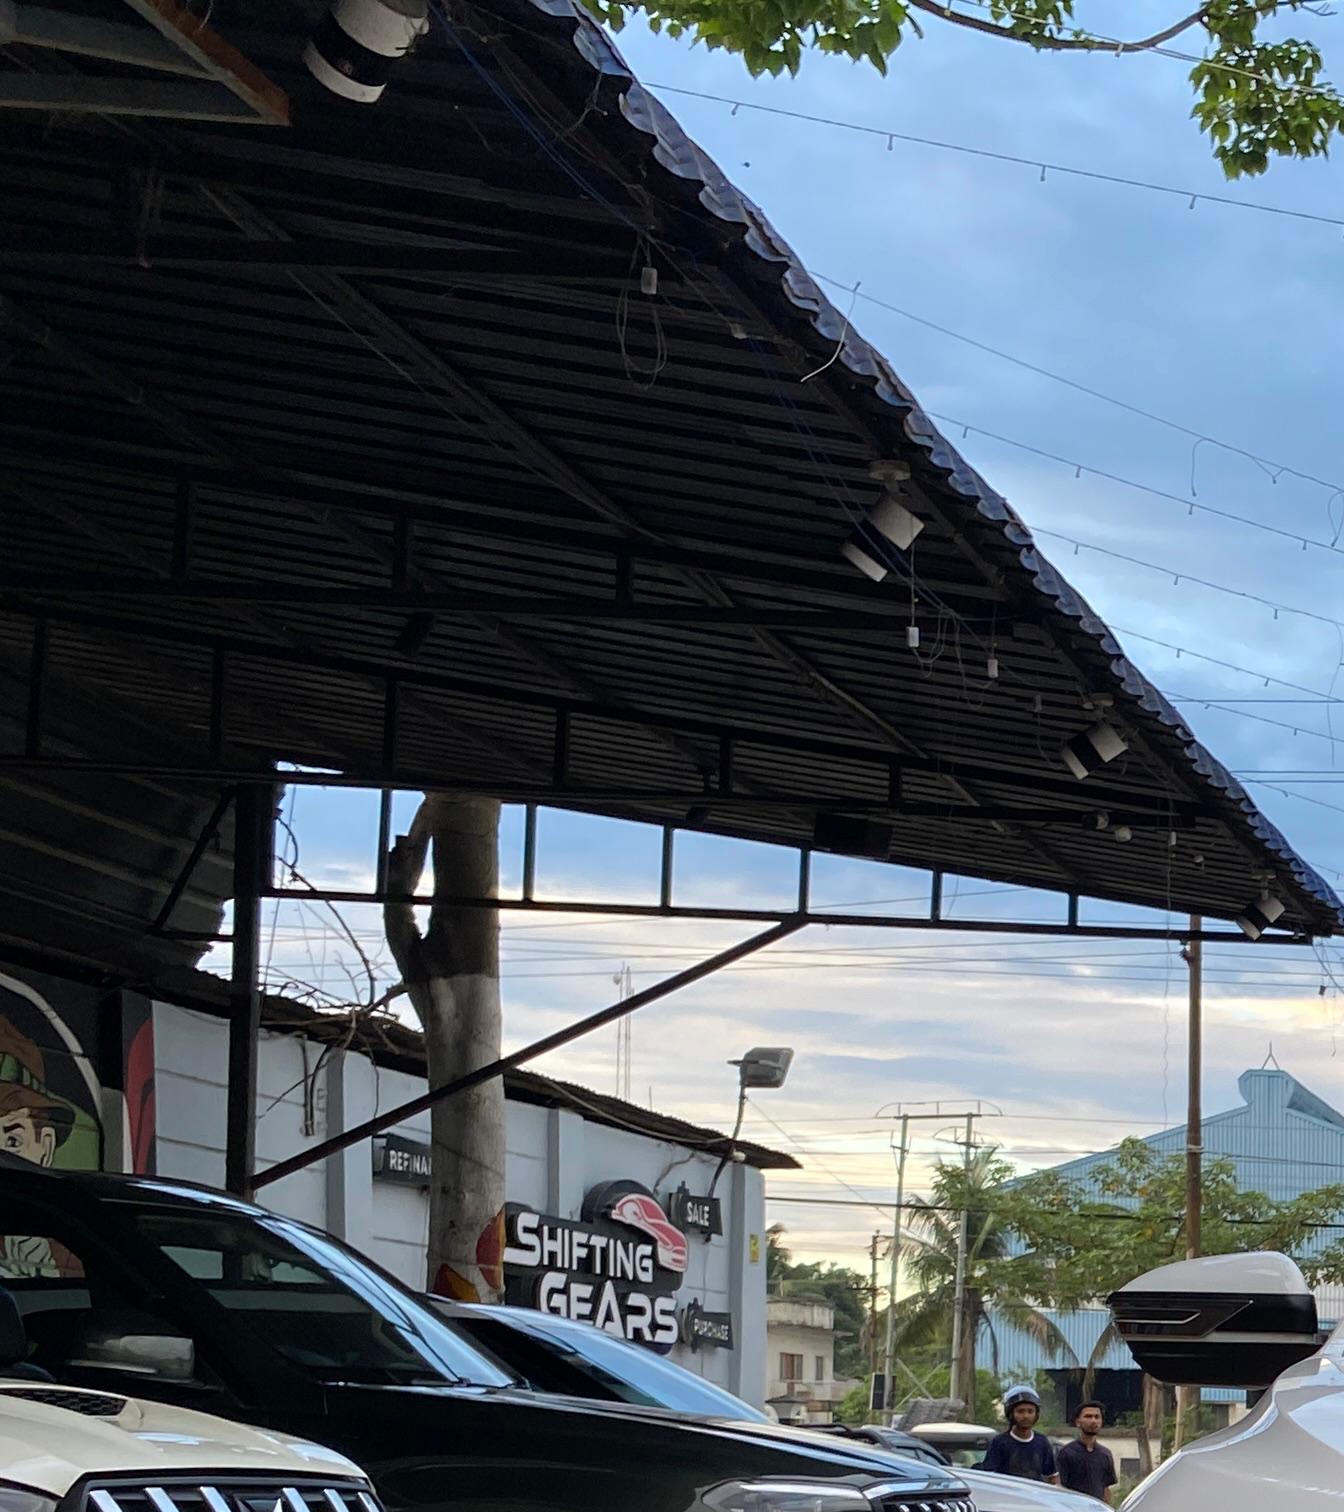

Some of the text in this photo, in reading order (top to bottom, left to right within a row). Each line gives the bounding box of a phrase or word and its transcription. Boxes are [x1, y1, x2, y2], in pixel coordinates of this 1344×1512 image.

[389, 1149, 432, 1176] REFINA
[687, 1202, 709, 1226] SALE
[503, 1211, 653, 1283] SHIFTING
[540, 1271, 679, 1344] GEARS
